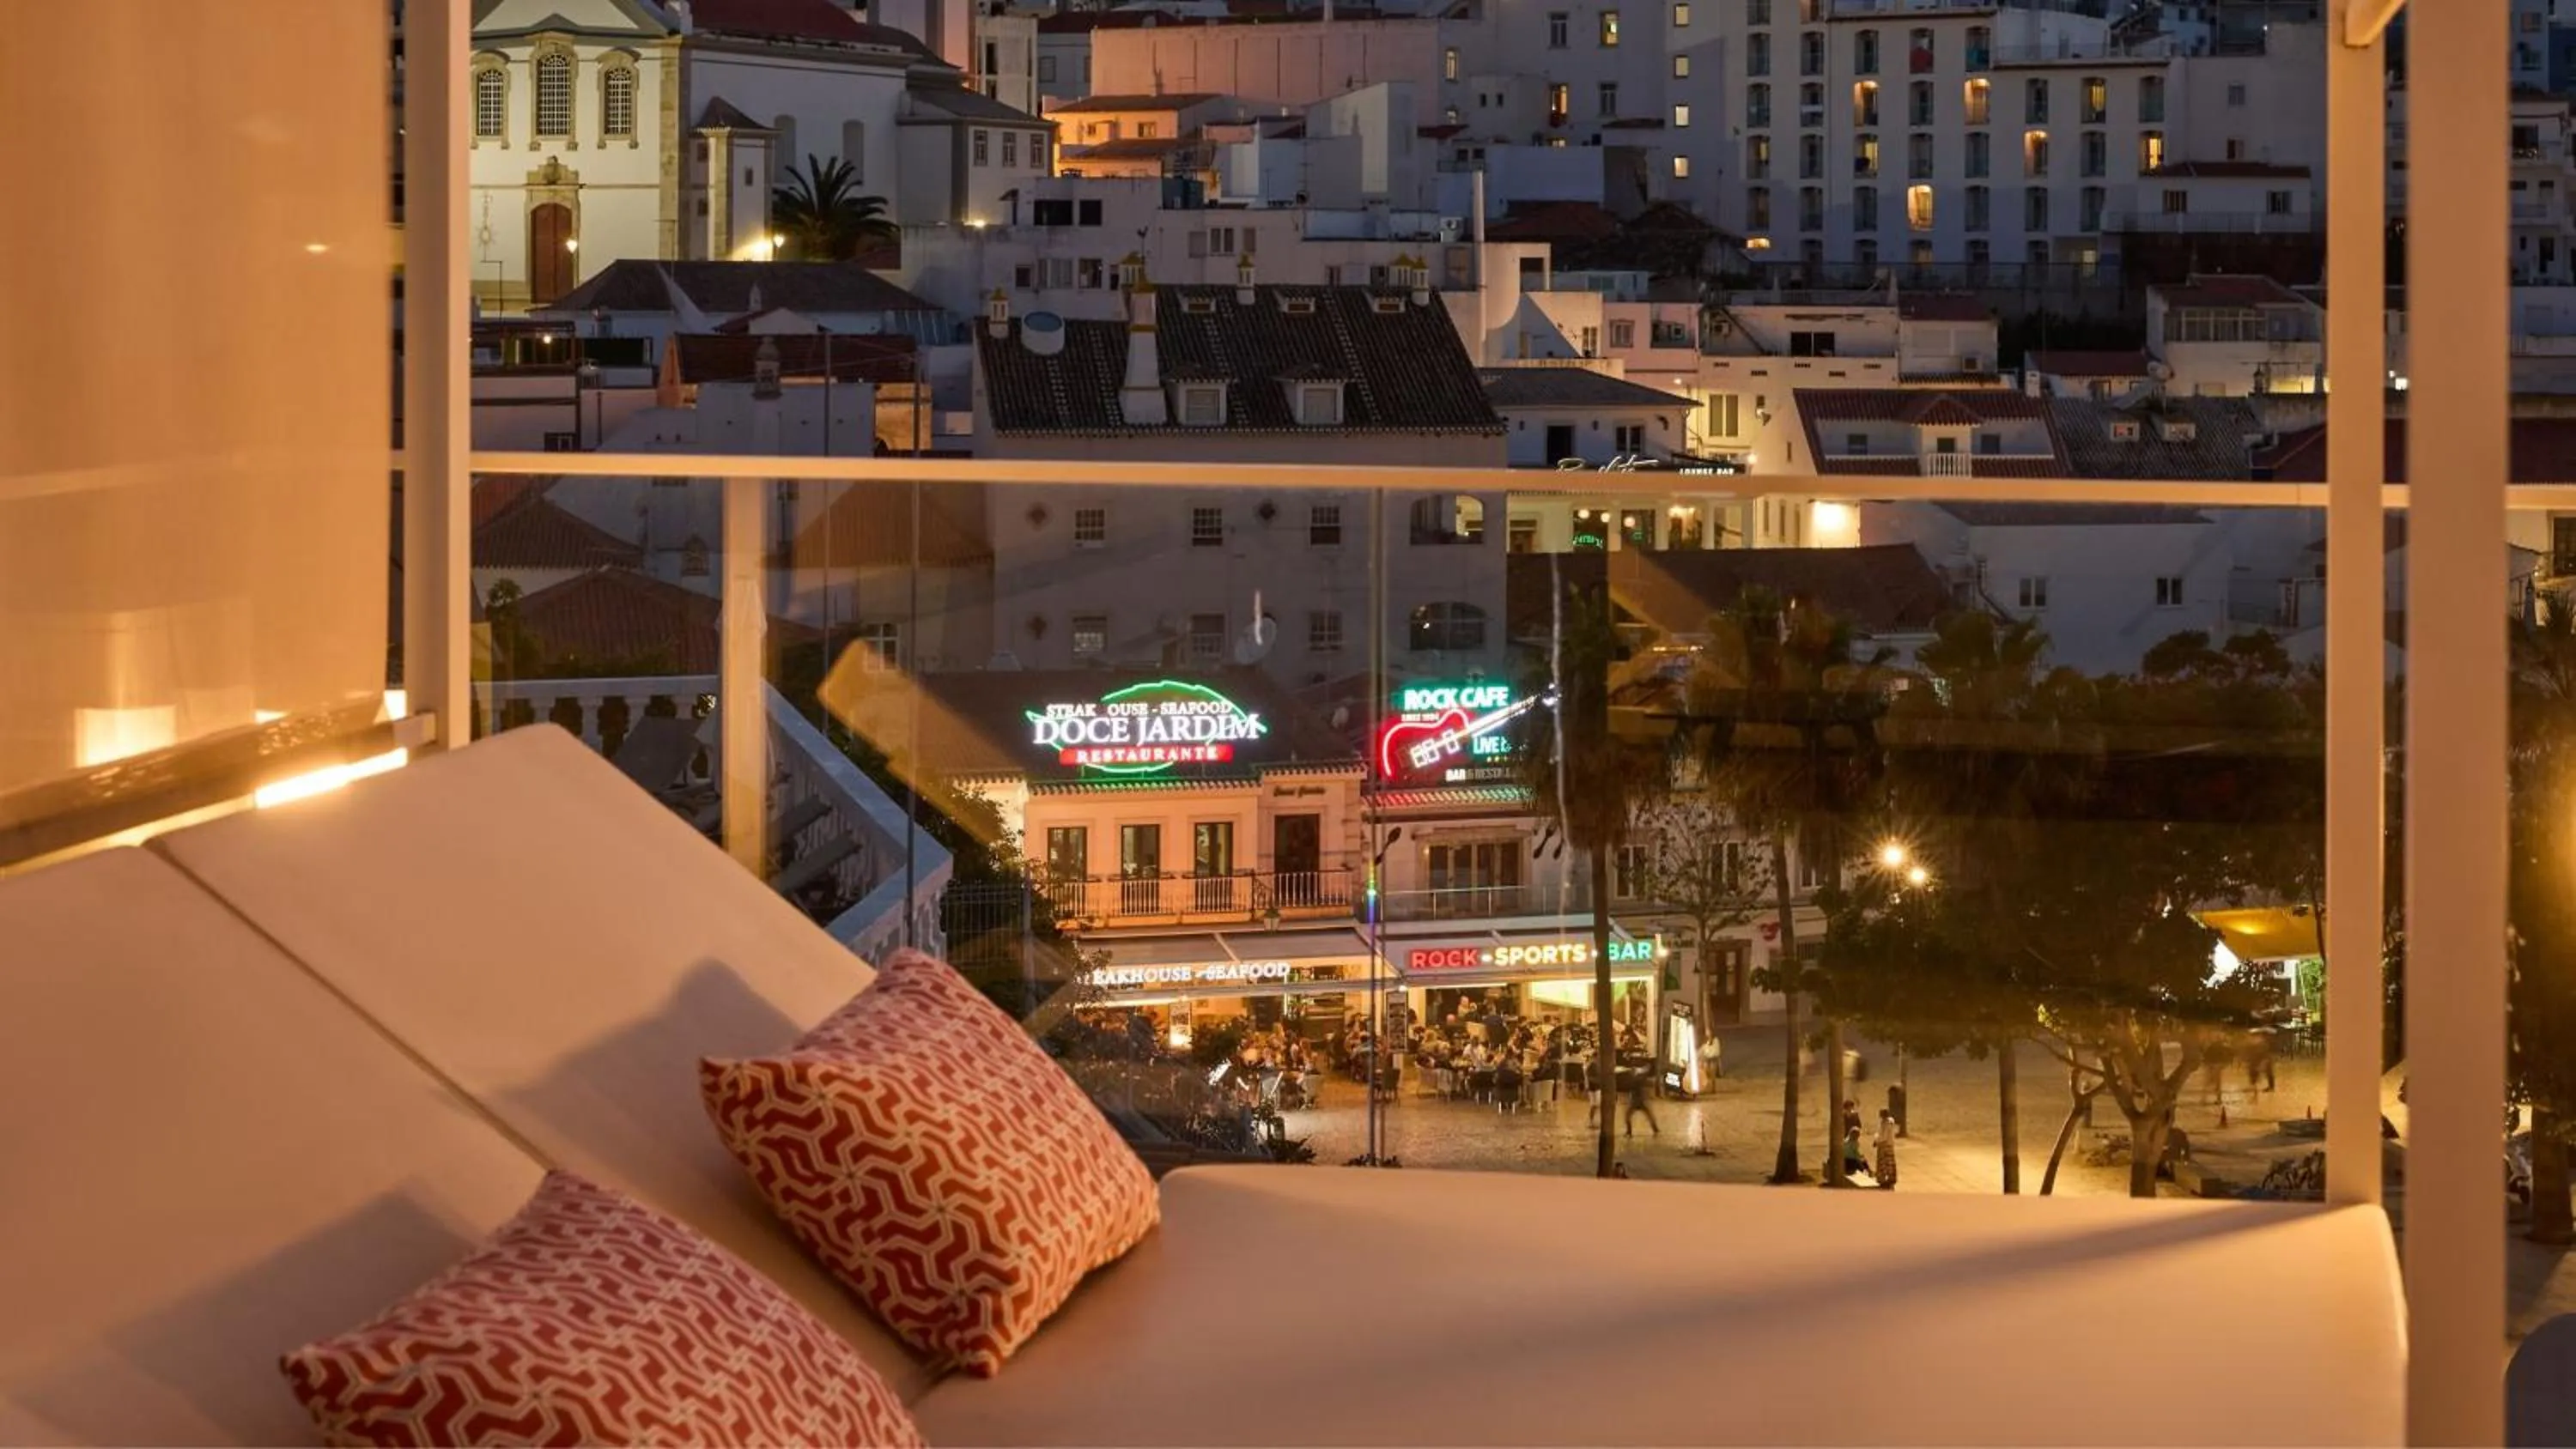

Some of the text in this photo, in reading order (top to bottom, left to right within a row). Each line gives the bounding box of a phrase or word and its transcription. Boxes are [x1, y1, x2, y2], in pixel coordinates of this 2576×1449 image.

[1160, 701, 1232, 715] SEAFOOD
[1404, 686, 1510, 711] ROCK CAFE
[1033, 713, 1259, 747] DOCE JARDIM
[1075, 746, 1218, 764] RESTAURANTE
[1473, 736, 1500, 755] LIVE
[1411, 949, 1478, 969] ROCK
[1494, 943, 1587, 967] SPORTS
[1609, 941, 1652, 961] BAR
[1075, 966, 1192, 985] EAKHOUSE
[1206, 961, 1291, 980] SEAFOOD
